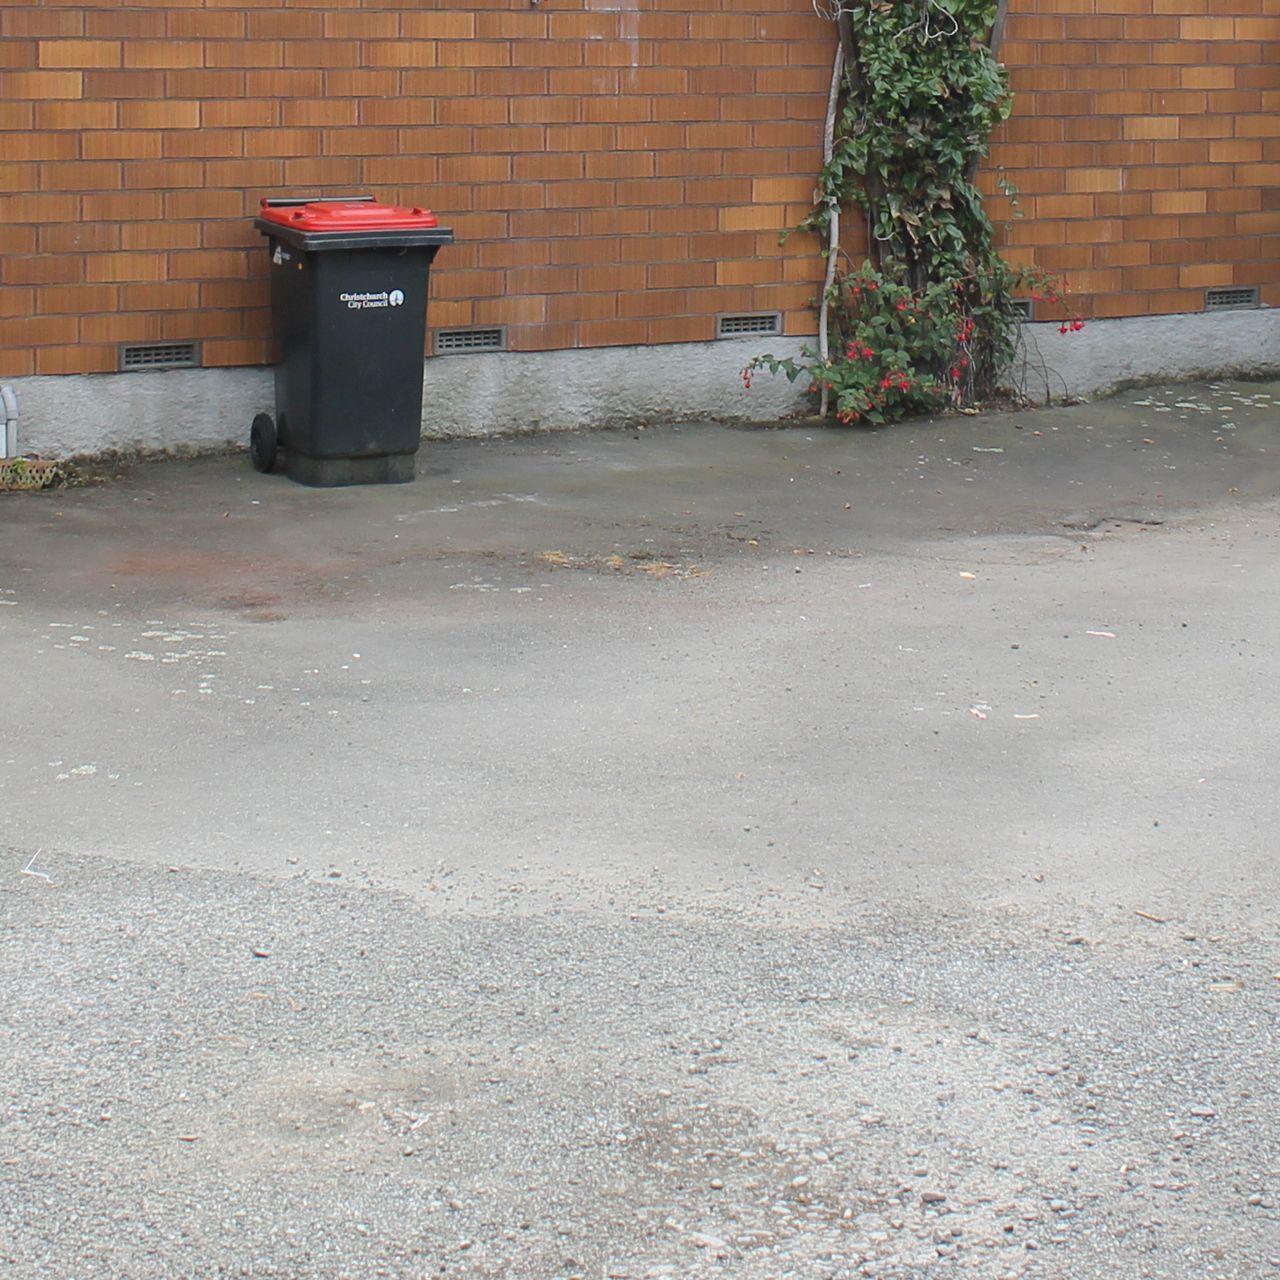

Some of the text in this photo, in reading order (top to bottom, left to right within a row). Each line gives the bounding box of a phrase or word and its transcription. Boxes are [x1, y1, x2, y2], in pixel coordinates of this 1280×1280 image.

[340, 291, 388, 301] Christchurch
[348, 300, 388, 309] City Council
